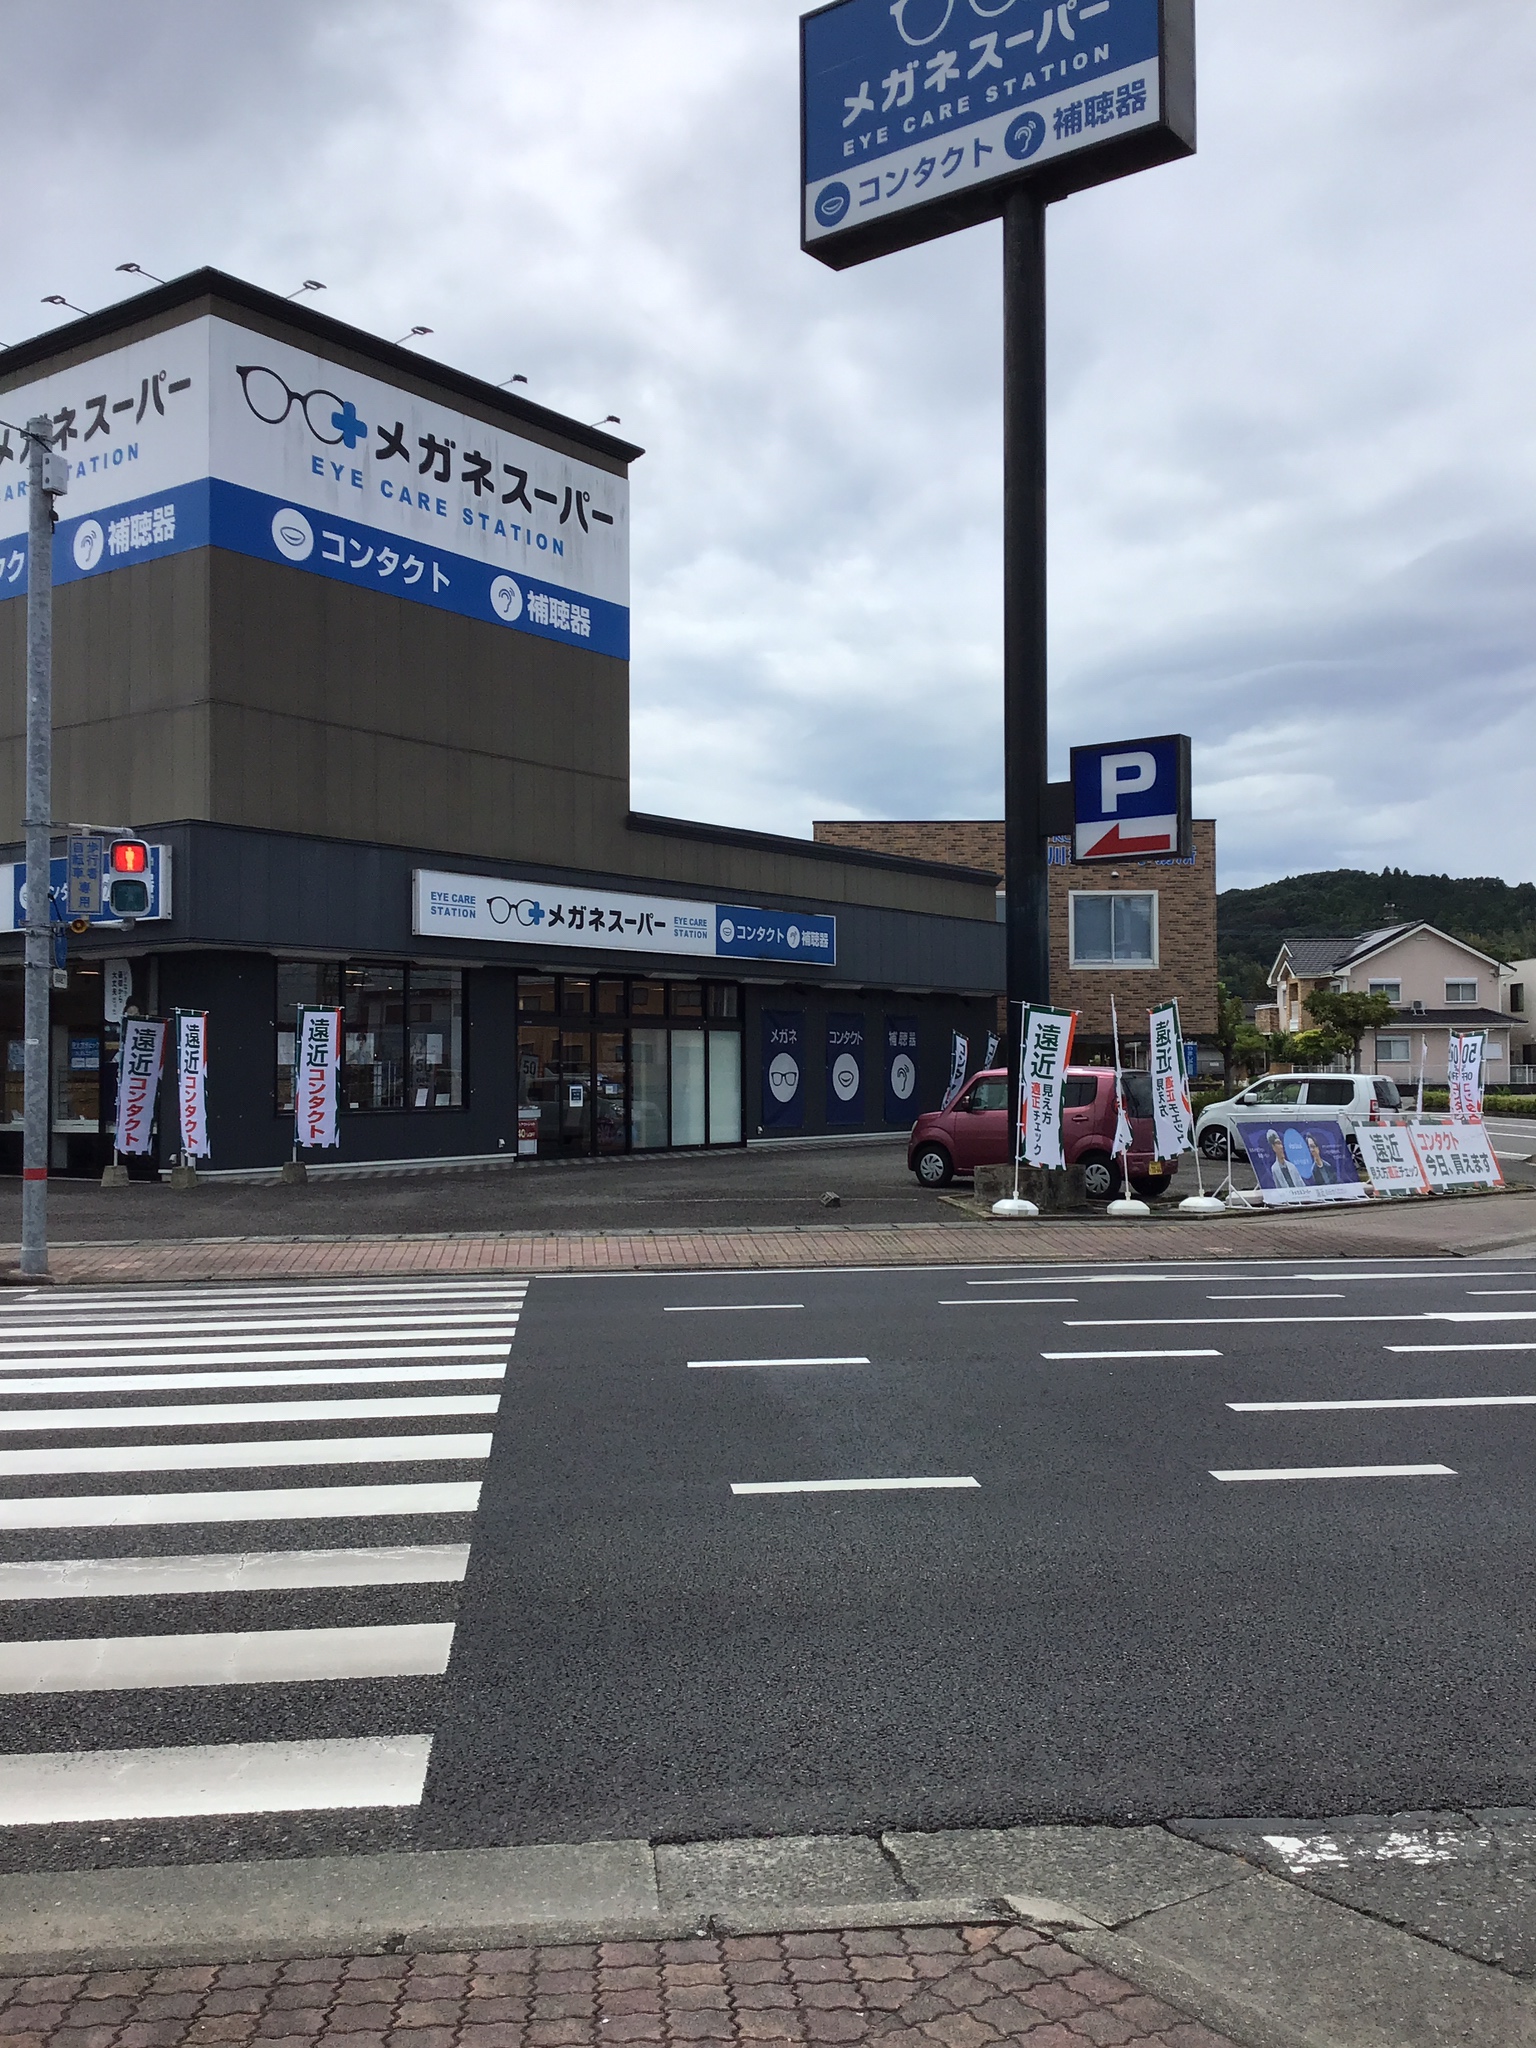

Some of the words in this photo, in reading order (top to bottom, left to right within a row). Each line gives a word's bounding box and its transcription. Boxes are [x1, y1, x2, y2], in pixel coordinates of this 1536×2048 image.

[843, 0, 1109, 128] メガネスーパー
[843, 127, 889, 157] EYE
[903, 95, 970, 134] CARE
[985, 43, 1110, 103] STATION
[859, 138, 994, 208] コンタクト
[1053, 78, 1147, 140] 補聴器
[376, 421, 614, 534] メガネスーパー
[311, 455, 364, 489] EYE
[380, 480, 448, 517] CARE
[462, 507, 565, 557] STATION
[108, 503, 176, 556] 補聴器
[322, 530, 450, 593] コンタクト
[526, 590, 592, 638] 補聴器
[1101, 751, 1157, 813] P
[430, 891, 449, 903] EYE
[451, 893, 476, 905] CARE
[430, 906, 476, 919] STATION
[548, 904, 666, 936] メガネスーパー
[674, 916, 688, 926] EYE
[689, 918, 708, 928] CARE
[674, 929, 708, 939] STATION
[737, 925, 785, 944] コンタクト
[801, 930, 829, 948] 補聴器
[771, 1029, 798, 1045] メガネ
[829, 1030, 863, 1045] コンタクト
[889, 1031, 917, 1047] 補聴器
[1031, 1023, 1061, 1080] 遠近
[1031, 1082, 1041, 1156] 適正チェック
[1042, 1084, 1053, 1125] 見え方
[1370, 1133, 1404, 1163] 遠近
[1417, 1132, 1459, 1150] コンタクト
[1426, 1153, 1490, 1176] 今日、買えます
